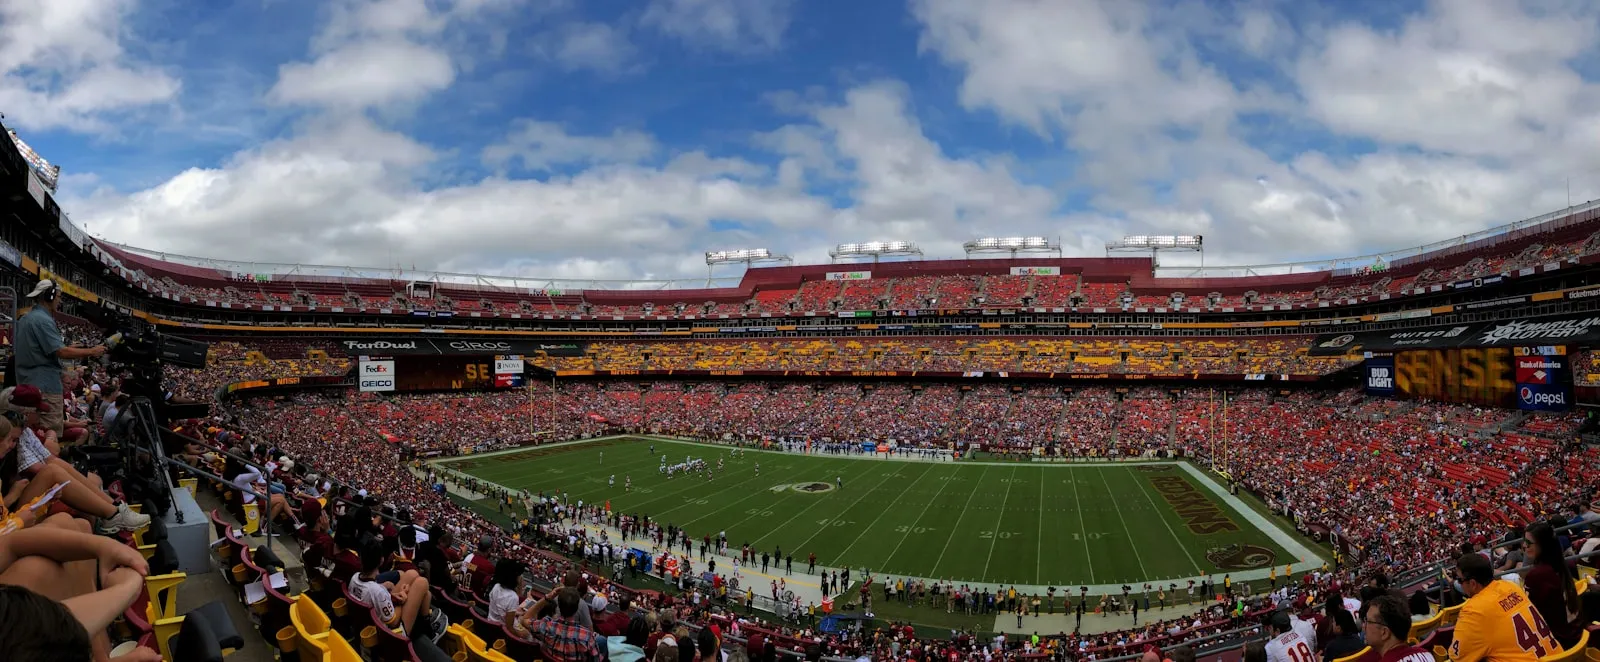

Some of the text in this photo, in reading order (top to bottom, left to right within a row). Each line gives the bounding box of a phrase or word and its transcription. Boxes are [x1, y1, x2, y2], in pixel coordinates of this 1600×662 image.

[1389, 330, 1446, 338] UNITED
[1510, 327, 1587, 340] LOTTERY
[343, 341, 417, 349] FanDuel
[365, 365, 387, 373] FedEx
[1520, 361, 1532, 369] Bank
[1538, 361, 1561, 369] America
[1371, 367, 1389, 378] BUD
[1368, 377, 1392, 388] LIGHT
[1535, 392, 1565, 406] pepsi
[1148, 476, 1243, 535] REDSKINS
[895, 525, 926, 534] 30
[979, 531, 1011, 539] 20
[1071, 532, 1100, 541] 10
[1511, 603, 1558, 660] 44
[1287, 641, 1315, 662] 18
